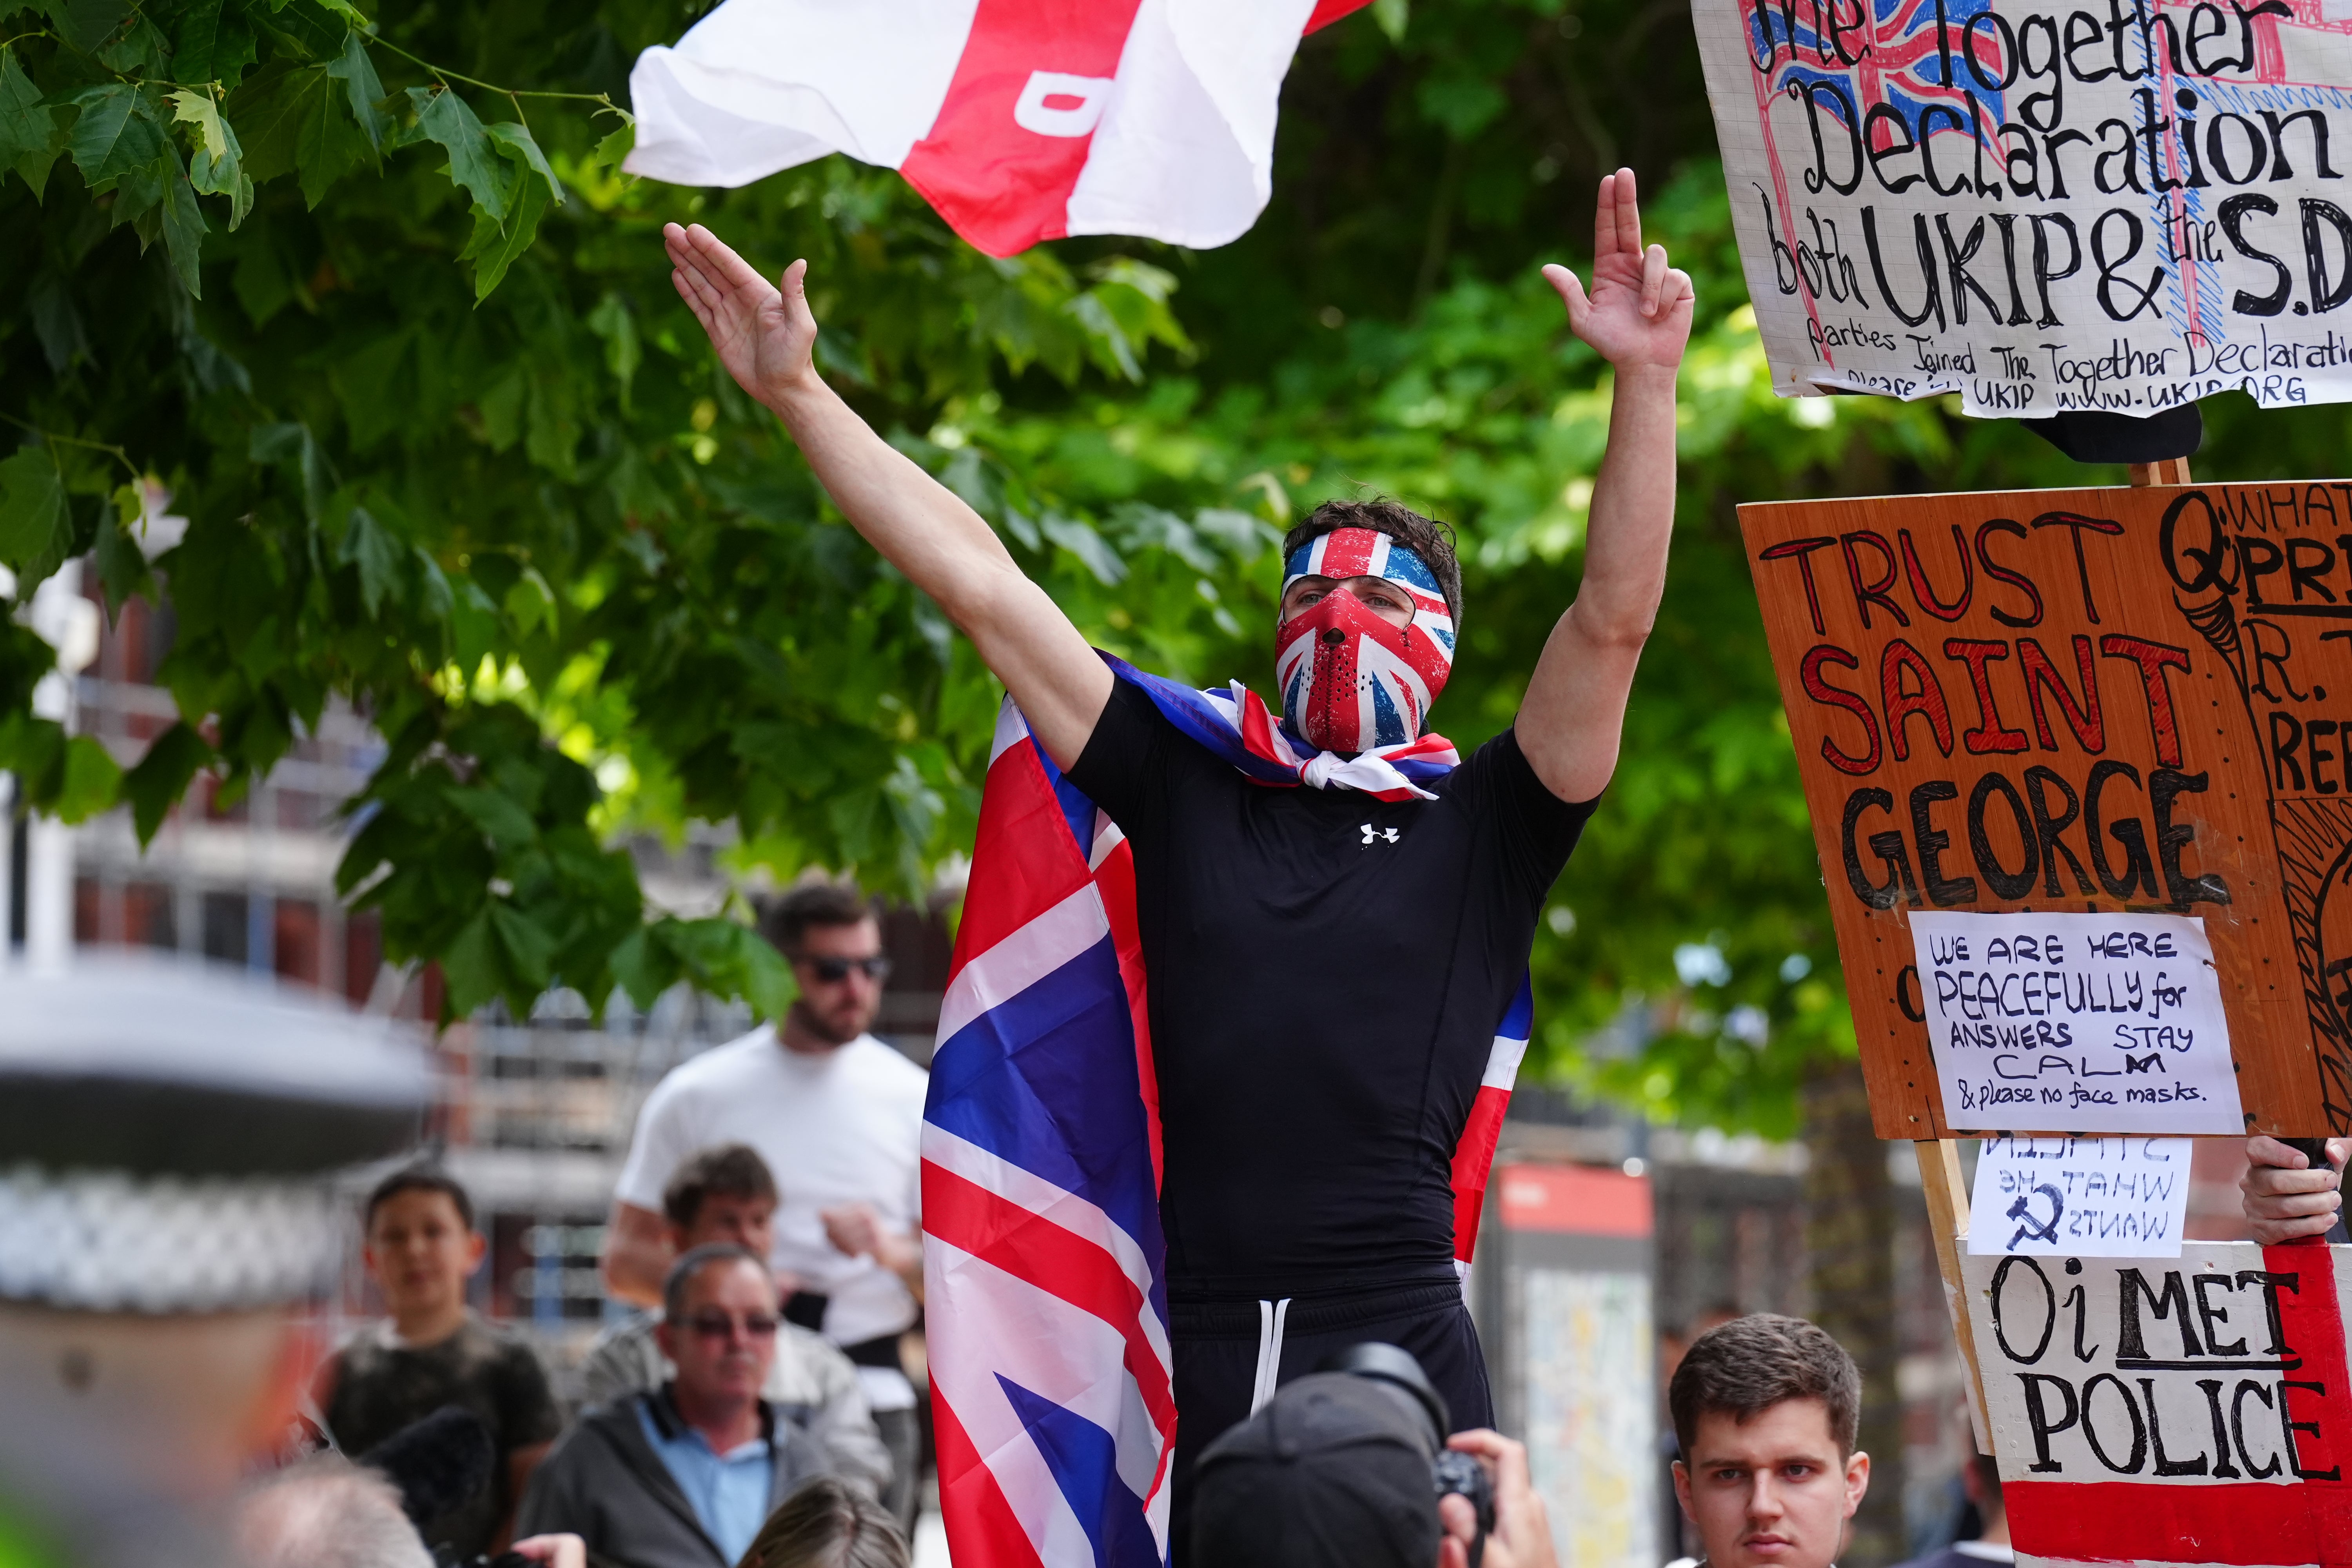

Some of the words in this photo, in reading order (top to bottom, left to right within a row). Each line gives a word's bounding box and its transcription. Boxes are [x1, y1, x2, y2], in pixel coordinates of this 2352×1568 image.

[1787, 78, 2344, 201] Declaration
[1753, 182, 1869, 310] both
[1860, 205, 2081, 333] UKIP
[2091, 208, 2166, 321] &
[2157, 195, 2223, 263] the
[1807, 317, 1896, 361] parties
[1989, 346, 2036, 381] The
[2039, 338, 2178, 401] Together
[2184, 324, 2352, 377] Declarati
[1974, 377, 2034, 410] UKIP
[2222, 483, 2352, 533] WHAT
[1759, 511, 2125, 635] TRUST
[1800, 633, 2192, 777] SAINT
[1841, 759, 2233, 911] GEORGE
[1930, 934, 1970, 966] WE
[1987, 935, 2064, 964] ARE
[2087, 932, 2178, 960] HERE
[1934, 970, 2143, 1021] PEACEFULLY
[2148, 971, 2187, 1020] for
[1950, 1020, 2073, 1049] ANSWERS
[2113, 1024, 2194, 1053] STAY
[1958, 1079, 1975, 1110] &
[1980, 1081, 2035, 1111] please
[2042, 1087, 2063, 1104] no
[2068, 1081, 2118, 1109] face
[2126, 1081, 2207, 1104] masks.
[1993, 1053, 2166, 1080] CALM
[1991, 1255, 2100, 1366] Oi
[2115, 1268, 2300, 1359] MET
[2013, 1372, 2341, 1481] POLICE
